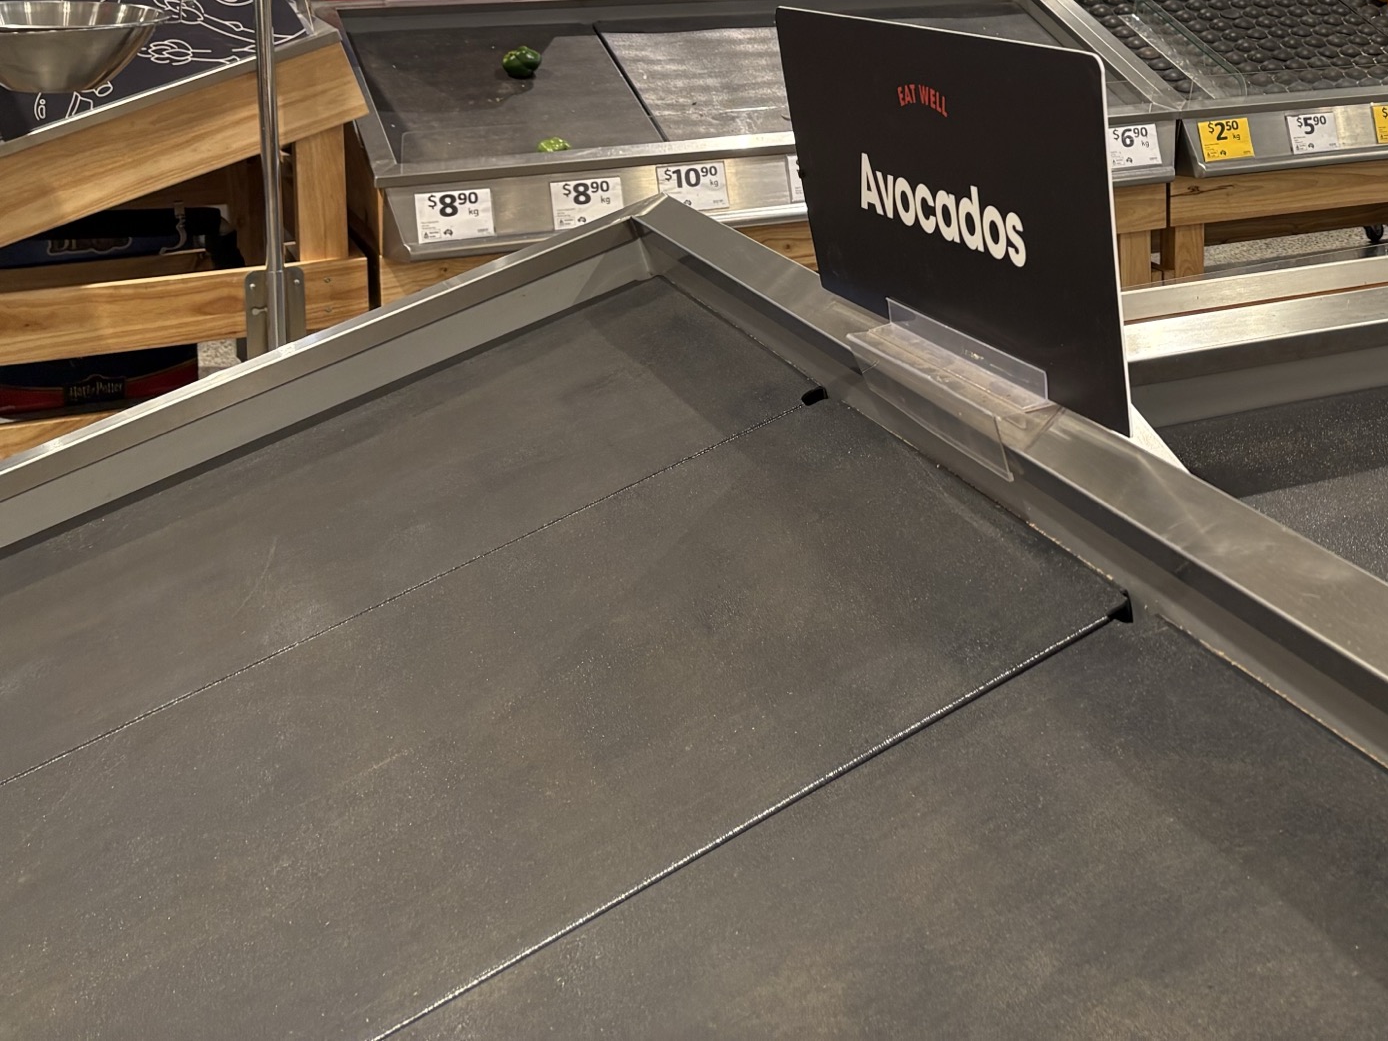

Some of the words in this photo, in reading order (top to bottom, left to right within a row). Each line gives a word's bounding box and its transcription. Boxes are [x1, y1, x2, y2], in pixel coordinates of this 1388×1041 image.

[897, 84, 916, 107] EAT
[918, 85, 948, 117] WELL
[468, 208, 479, 217] kg
[861, 152, 1026, 267] Avocados
